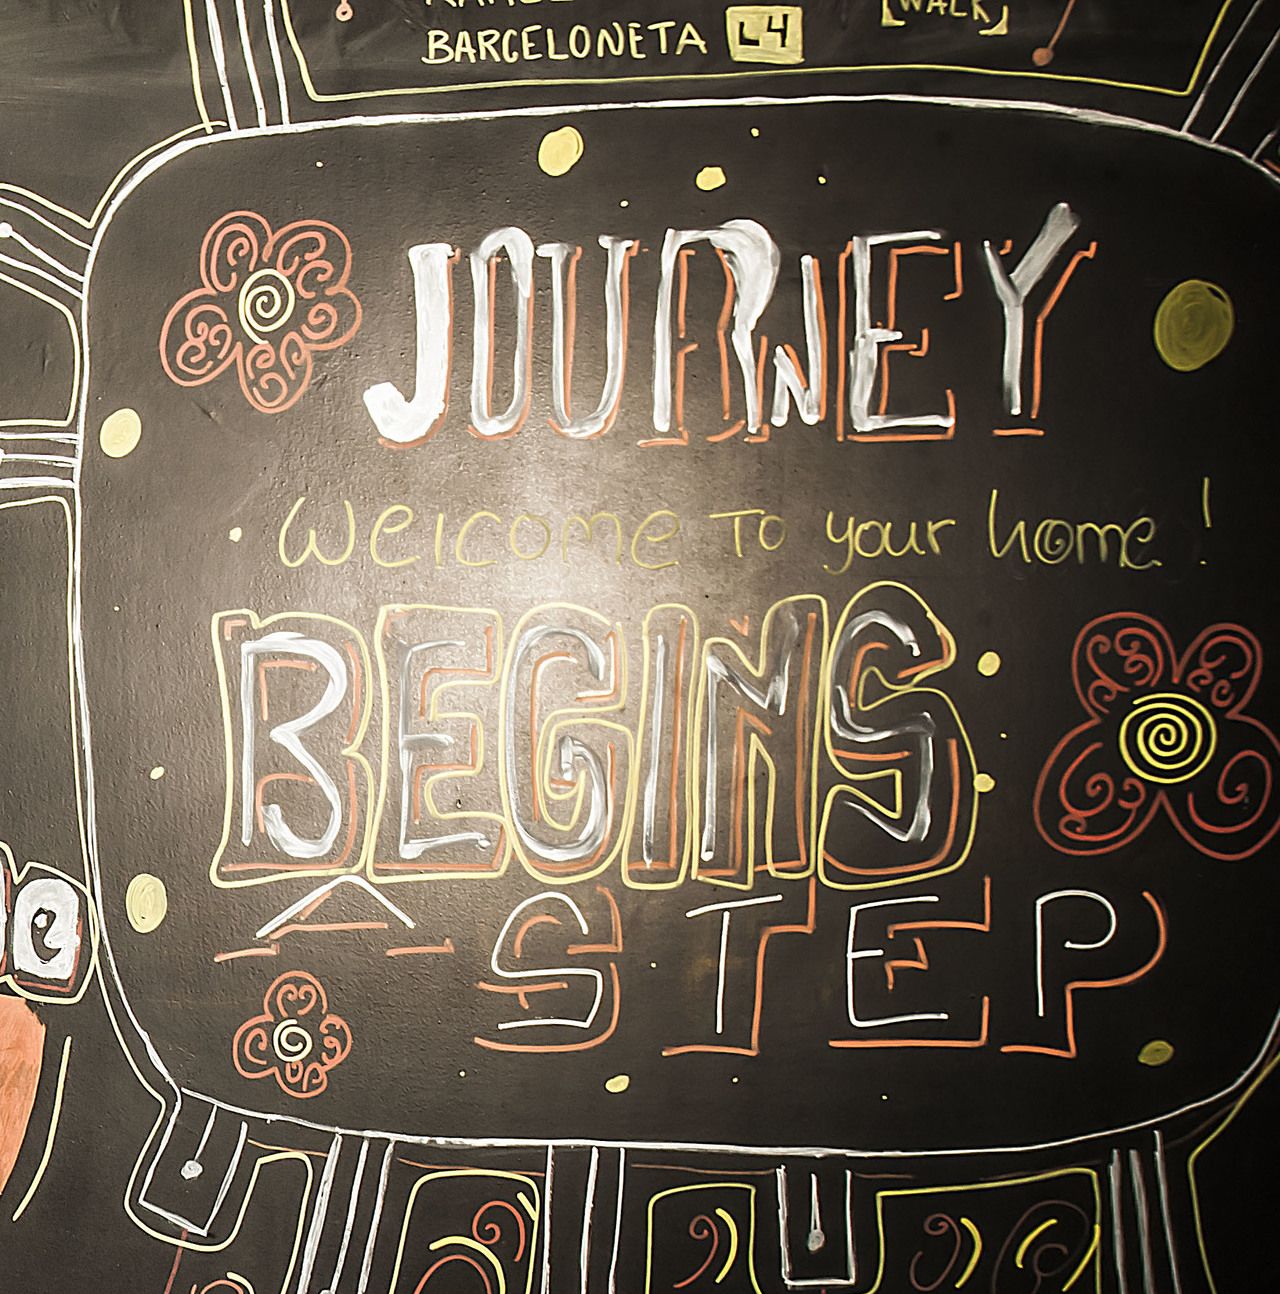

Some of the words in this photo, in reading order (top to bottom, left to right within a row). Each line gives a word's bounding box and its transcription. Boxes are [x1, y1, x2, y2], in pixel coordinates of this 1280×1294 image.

[421, 21, 707, 64] BARCELONETA
[824, 510, 956, 574] your
[211, 582, 978, 889] BEGINS
[474, 876, 1167, 1058] STEP
